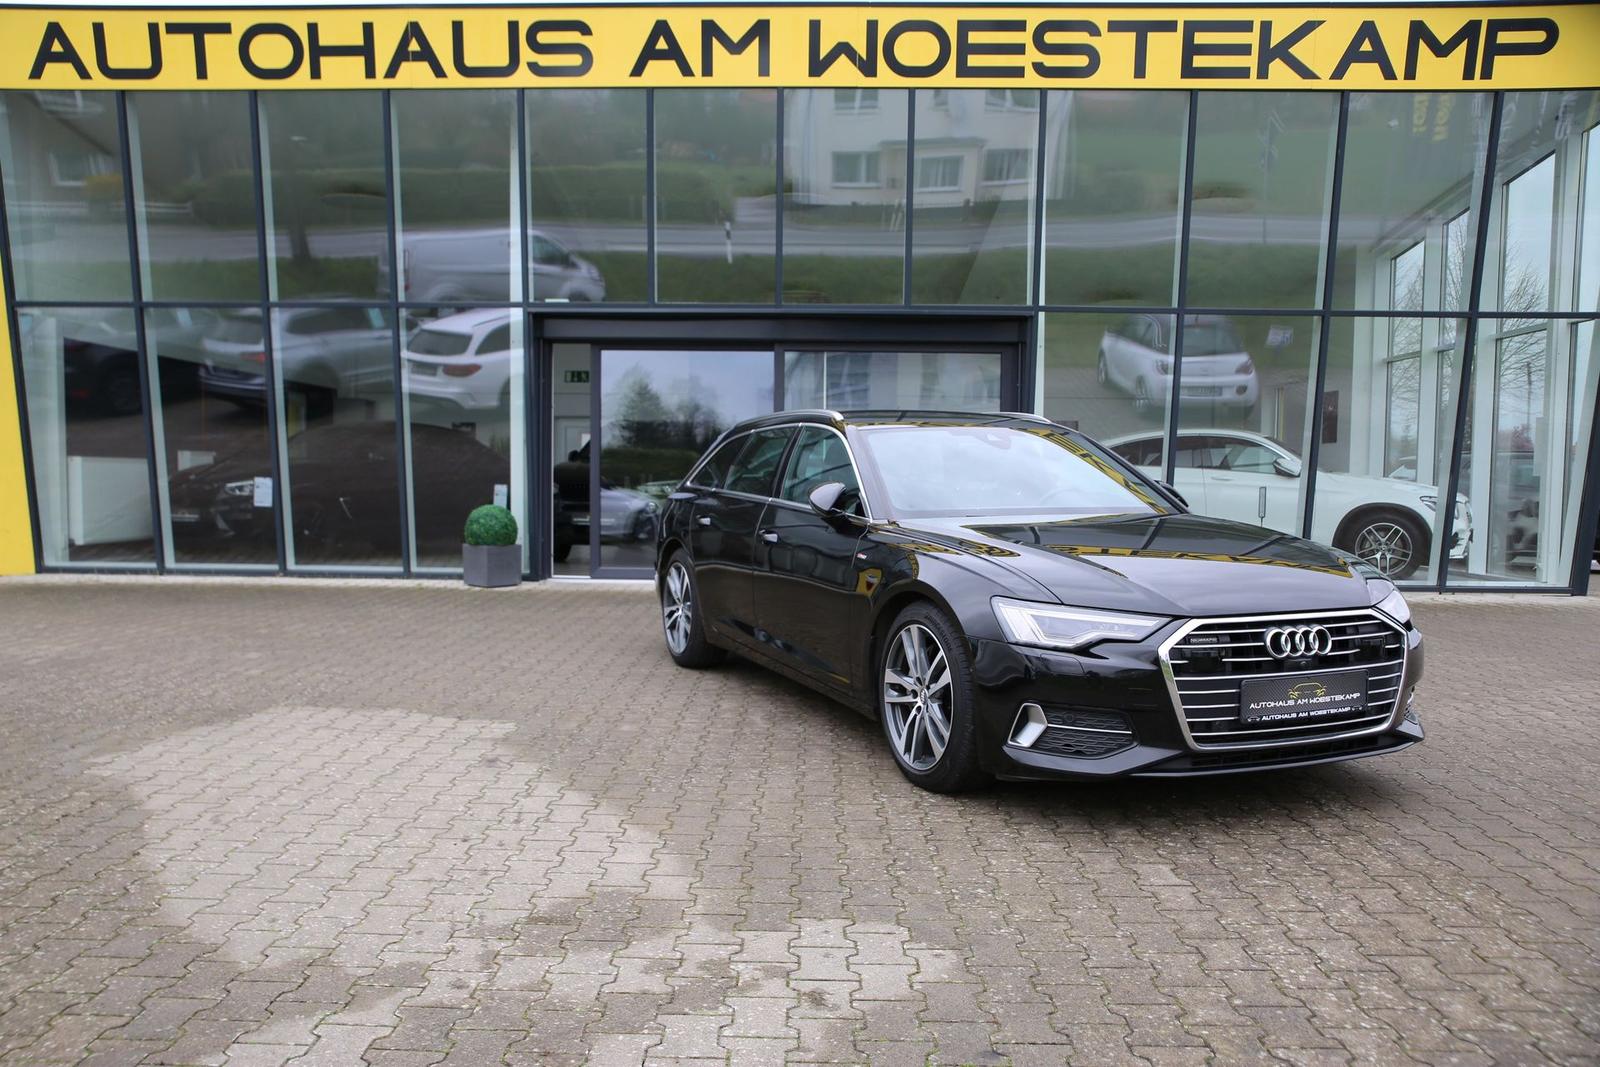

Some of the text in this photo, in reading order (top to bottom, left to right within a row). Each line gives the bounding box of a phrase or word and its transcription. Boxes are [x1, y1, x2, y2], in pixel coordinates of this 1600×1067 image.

[29, 18, 1559, 81] AUTOHAUS AM WOESTEKAMP
[1249, 699, 1295, 710] AUTOHAUS
[1309, 692, 1361, 704] WOESTEKAMP
[1261, 712, 1297, 721] AUTOHAUS
[1309, 706, 1351, 717] WOESTEKAMP
